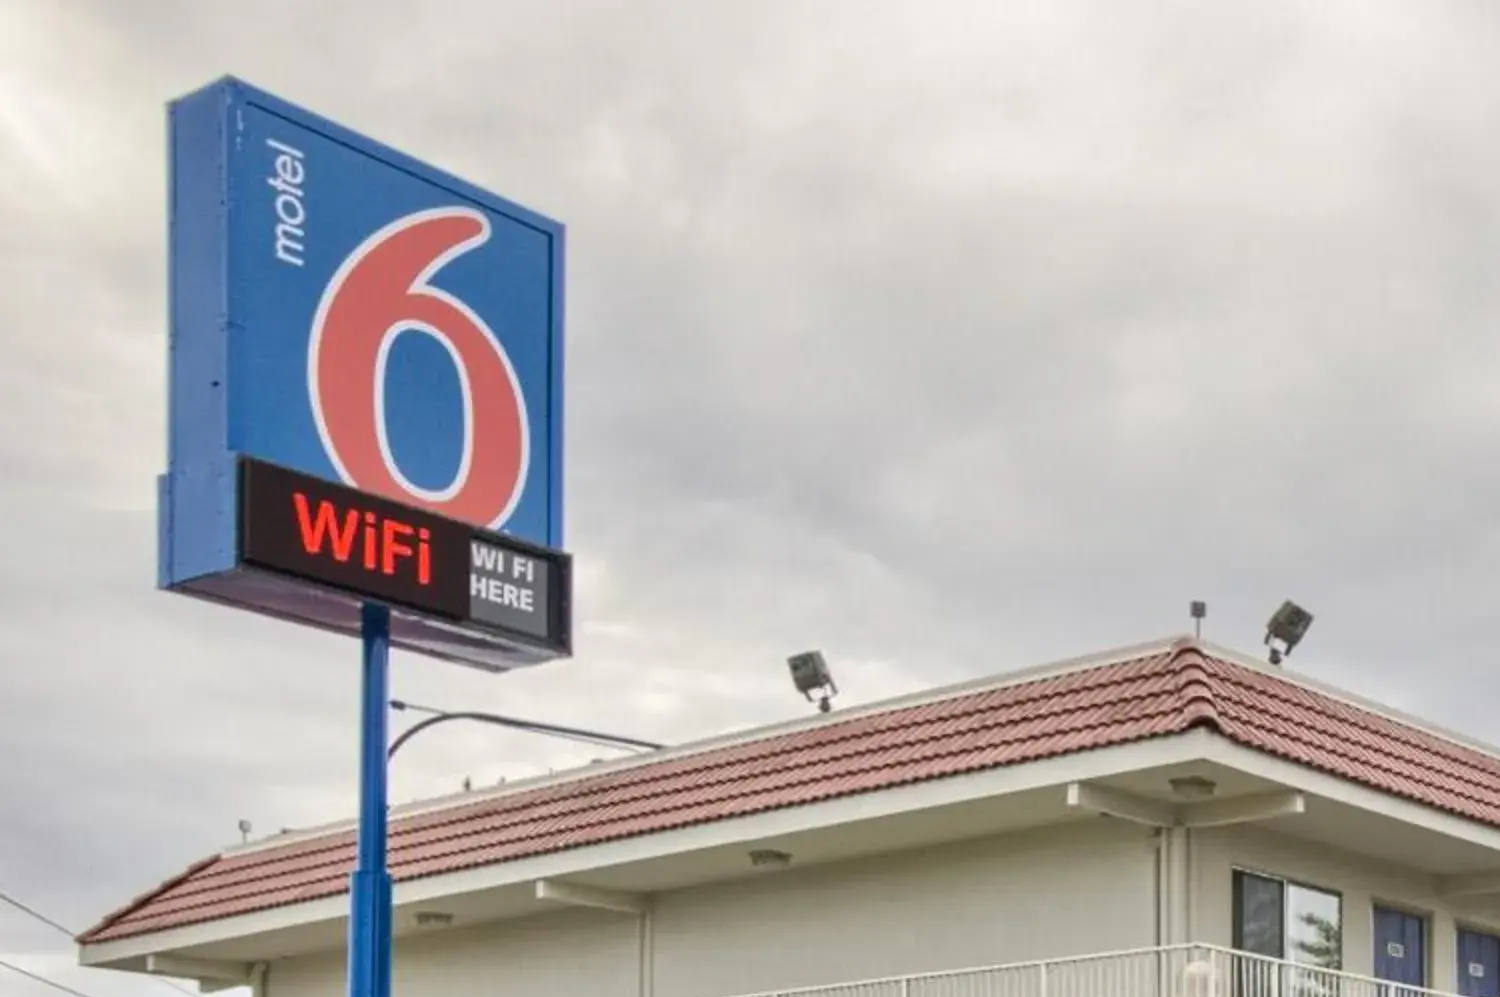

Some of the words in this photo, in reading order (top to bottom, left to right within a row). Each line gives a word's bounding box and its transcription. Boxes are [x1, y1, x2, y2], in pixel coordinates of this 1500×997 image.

[266, 139, 305, 266] motel
[307, 205, 530, 531] 6
[293, 493, 431, 584] WiFi
[470, 542, 503, 573] WI
[512, 557, 534, 582] FI
[470, 573, 535, 613] HERE
